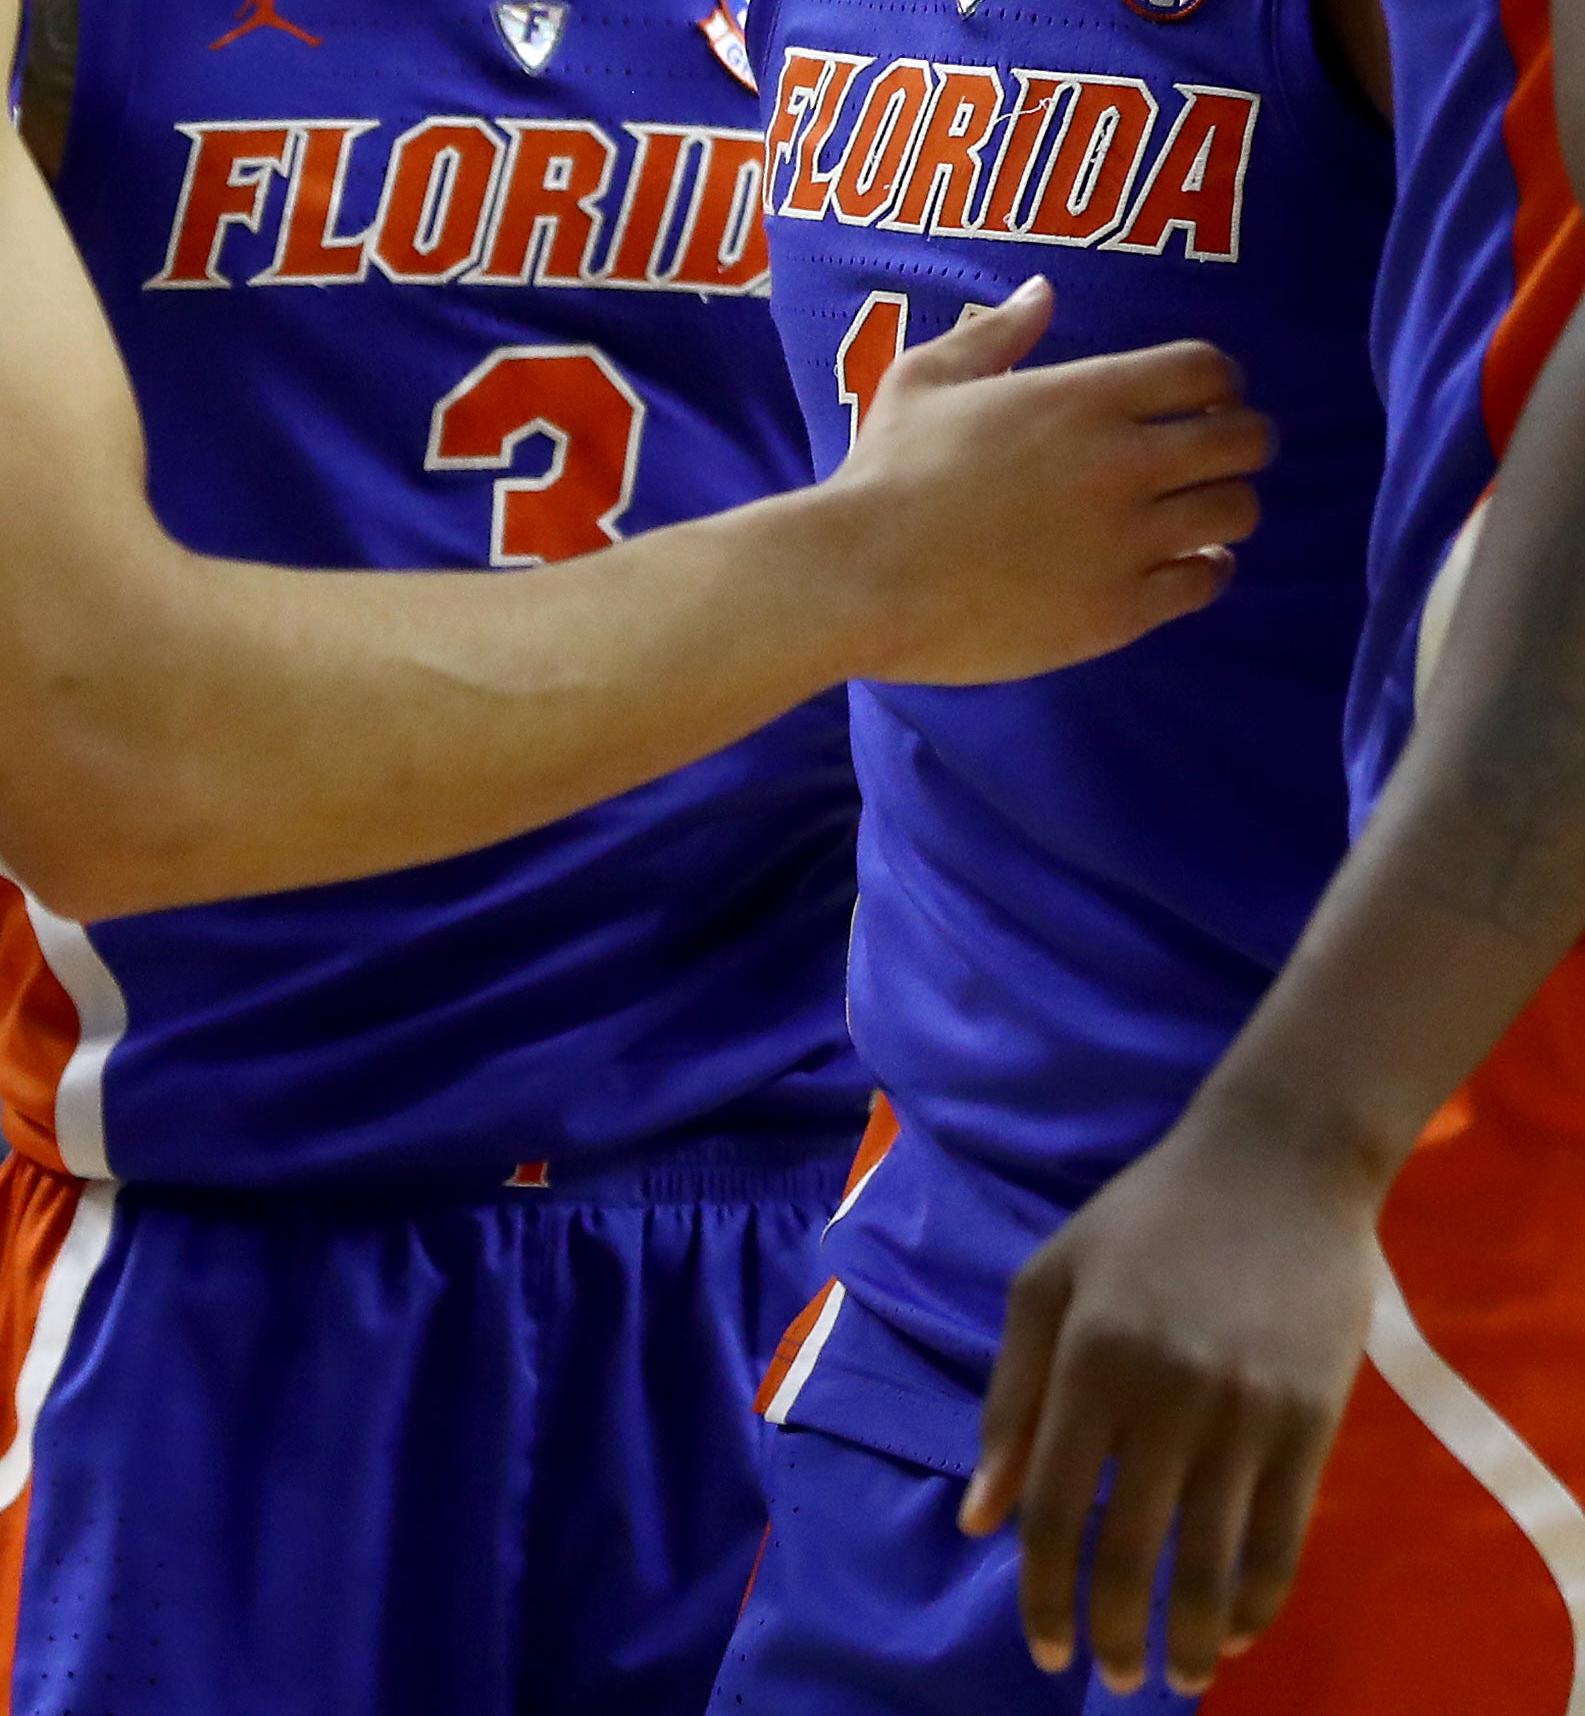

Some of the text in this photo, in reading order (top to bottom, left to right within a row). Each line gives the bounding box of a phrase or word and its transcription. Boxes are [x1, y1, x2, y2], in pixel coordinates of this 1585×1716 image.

[142, 116, 771, 301] FLORID
[763, 46, 1261, 264] FLORIDA
[423, 344, 646, 569] 3
